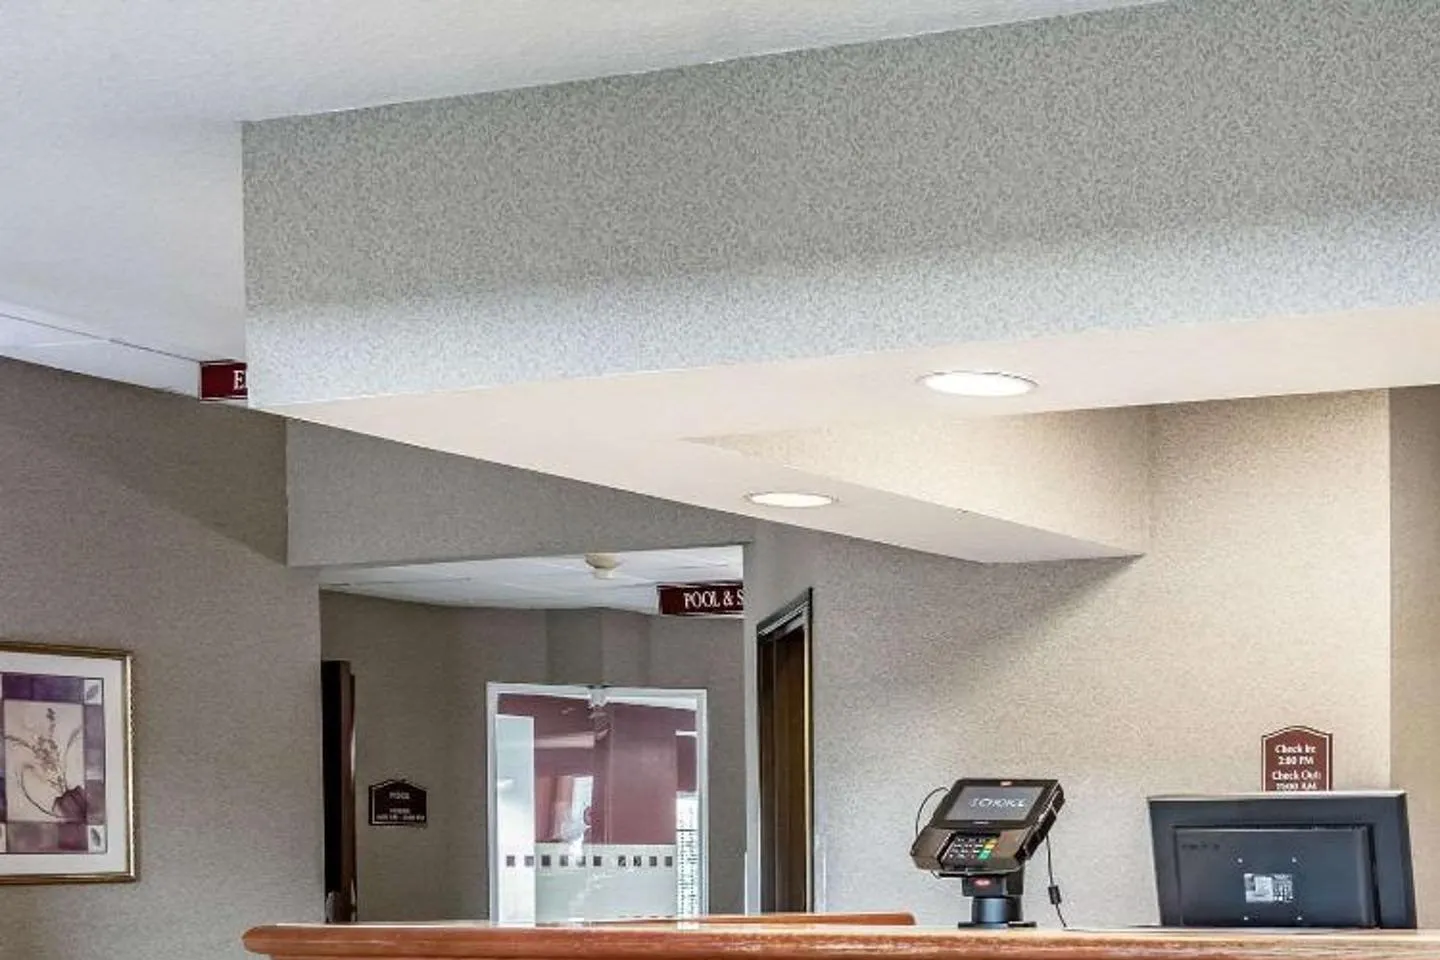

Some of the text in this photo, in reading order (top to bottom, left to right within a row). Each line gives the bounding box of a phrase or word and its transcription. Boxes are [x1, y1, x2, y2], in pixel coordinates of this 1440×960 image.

[683, 590, 721, 609] POOL
[723, 590, 734, 606] &
[1274, 743, 1302, 753] Check
[1299, 756, 1314, 765] PM
[1272, 770, 1299, 780] Check
[978, 797, 1026, 808] CHOICE
